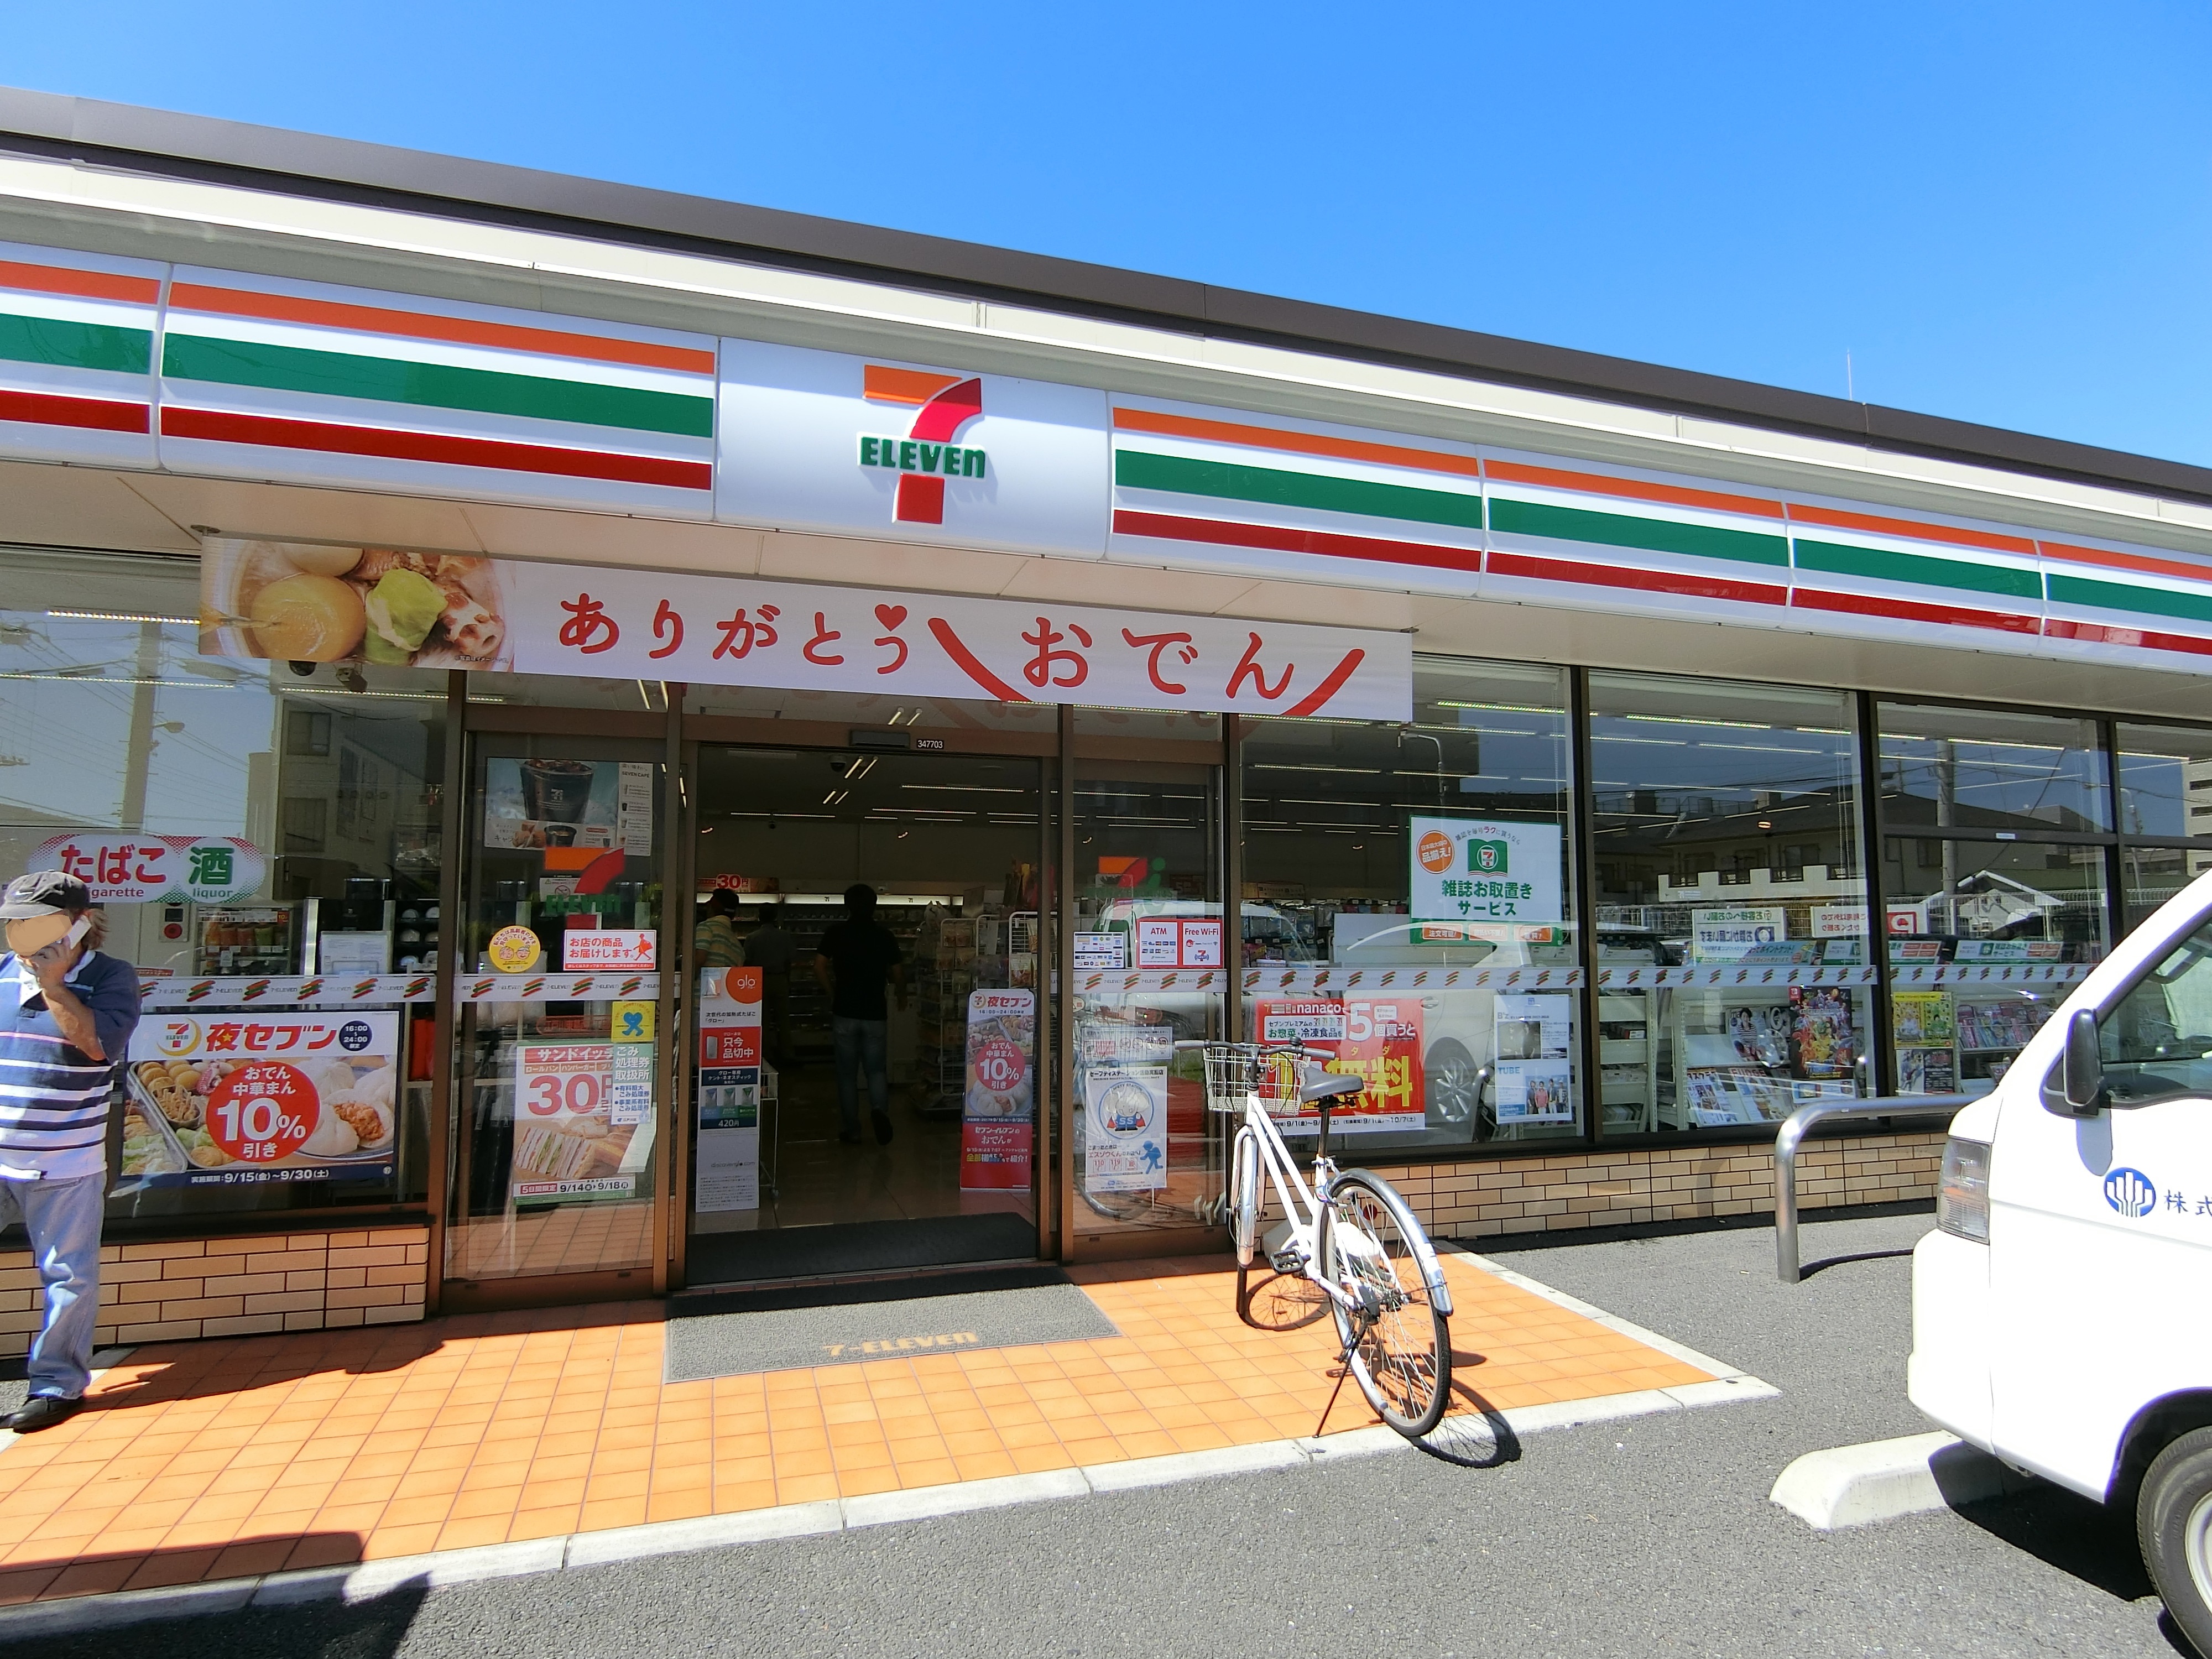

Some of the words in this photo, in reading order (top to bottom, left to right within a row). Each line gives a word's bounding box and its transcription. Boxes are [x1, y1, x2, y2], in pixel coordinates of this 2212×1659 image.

[559, 593, 911, 675] ありがとう
[1021, 615, 1295, 701] おでん
[917, 740, 943, 749] 347703
[61, 843, 166, 884] たばこ
[189, 846, 234, 885] 酒
[90, 887, 144, 899] garette
[192, 888, 233, 899] liquor
[1441, 879, 1532, 900] 雑誌お取置き
[1457, 900, 1516, 916] サービス
[569, 937, 623, 948] お店の商品
[569, 948, 634, 958] お届けします。
[737, 974, 756, 989] glo
[987, 996, 1032, 1008] 夜セブン
[206, 1022, 337, 1052] 夜セブン
[1374, 1023, 1416, 1037] 個買うと
[723, 1037, 744, 1048] 只今
[617, 1046, 639, 1057] ごみ
[723, 1047, 754, 1059] 品切中
[615, 1057, 650, 1068] 処理券
[979, 1057, 1020, 1081] 10%
[244, 1066, 291, 1081] おでん
[615, 1069, 650, 1081] 取扱所
[233, 1081, 297, 1096] 中華まん
[991, 1081, 1008, 1089] 引き
[217, 1097, 306, 1141] 10%
[1119, 1117, 1134, 1125] SS
[242, 1142, 278, 1159] 引き
